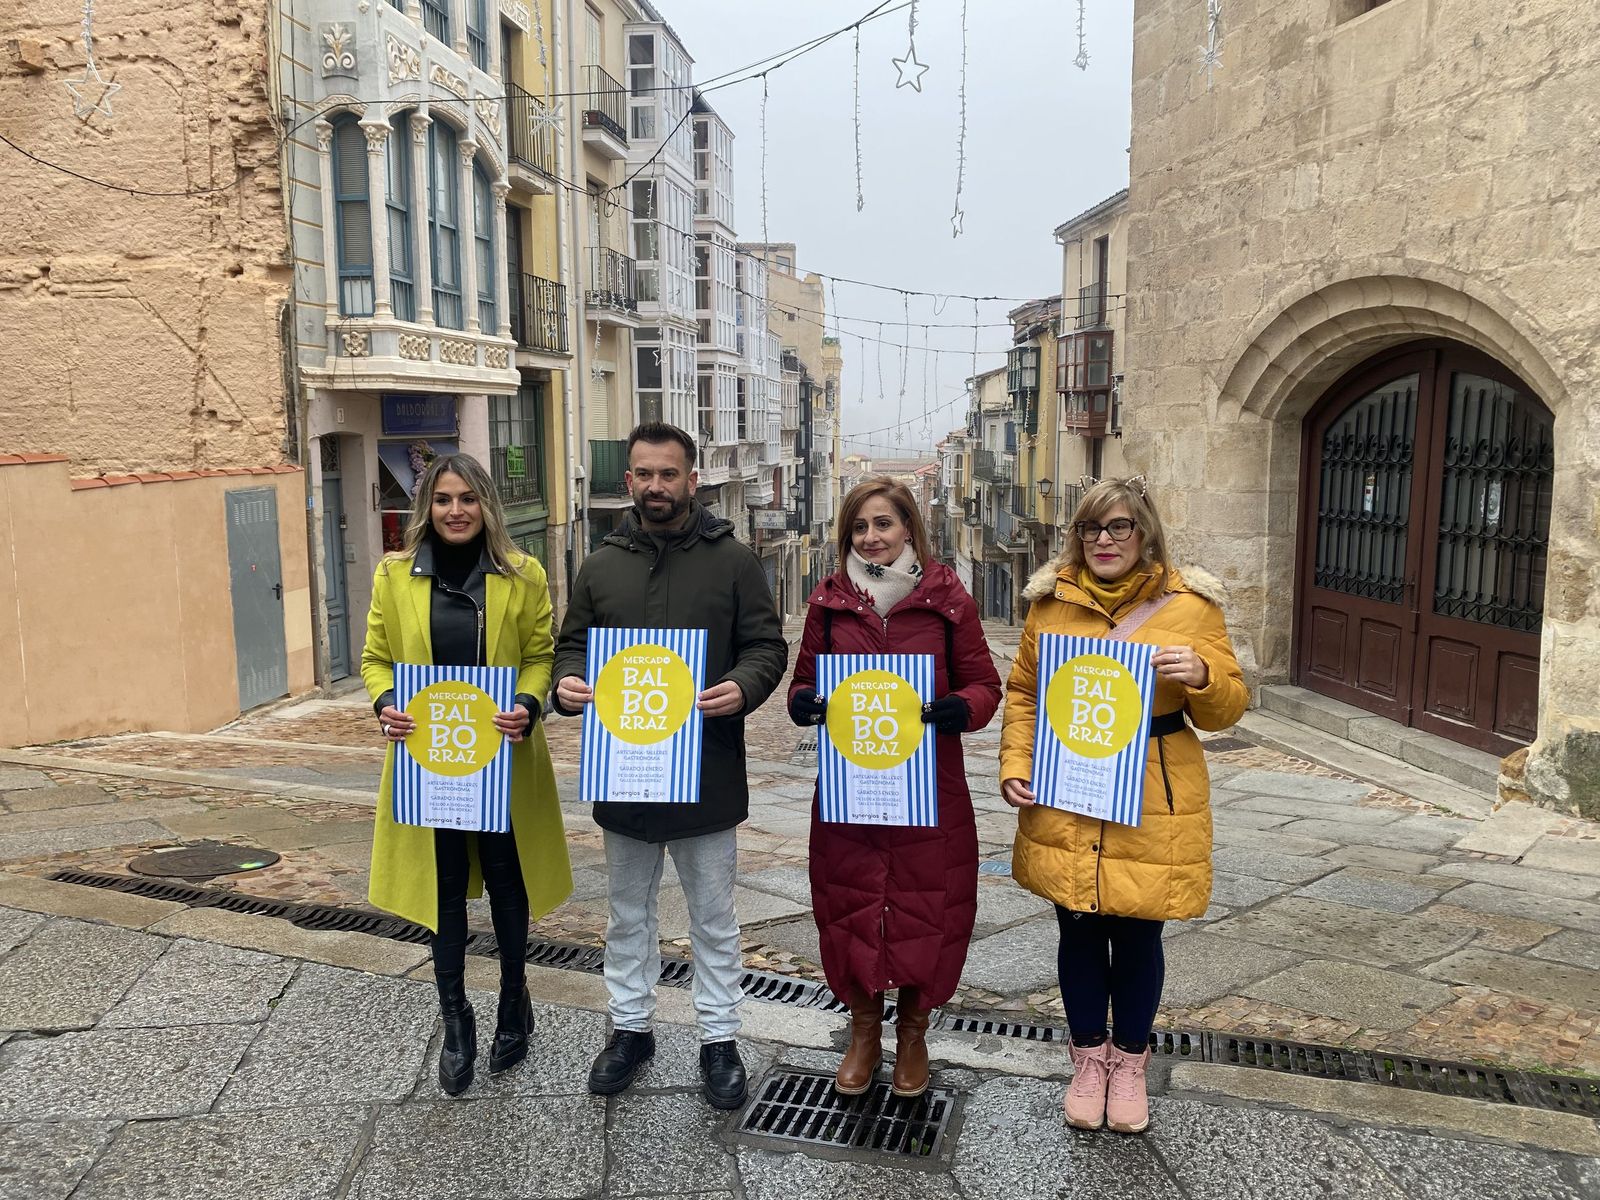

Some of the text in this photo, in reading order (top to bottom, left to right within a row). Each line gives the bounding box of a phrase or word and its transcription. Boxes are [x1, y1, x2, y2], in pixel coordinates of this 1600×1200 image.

[623, 656, 671, 664] MERCADO
[622, 667, 669, 687] BAL
[1074, 665, 1121, 678] MERCADO
[851, 681, 898, 690] MERCADO
[1073, 676, 1117, 702] BAL
[429, 692, 478, 702] MERCADO
[621, 690, 669, 715] BO
[851, 693, 897, 713] BAL
[428, 703, 476, 723] BAL
[619, 715, 668, 730] RRAZ
[1071, 698, 1116, 730] BO
[428, 723, 477, 750] BO
[851, 715, 899, 741] BO
[1068, 724, 1114, 747] RRAZ
[428, 749, 476, 764] RRAZ
[852, 741, 900, 756] RRAZ
